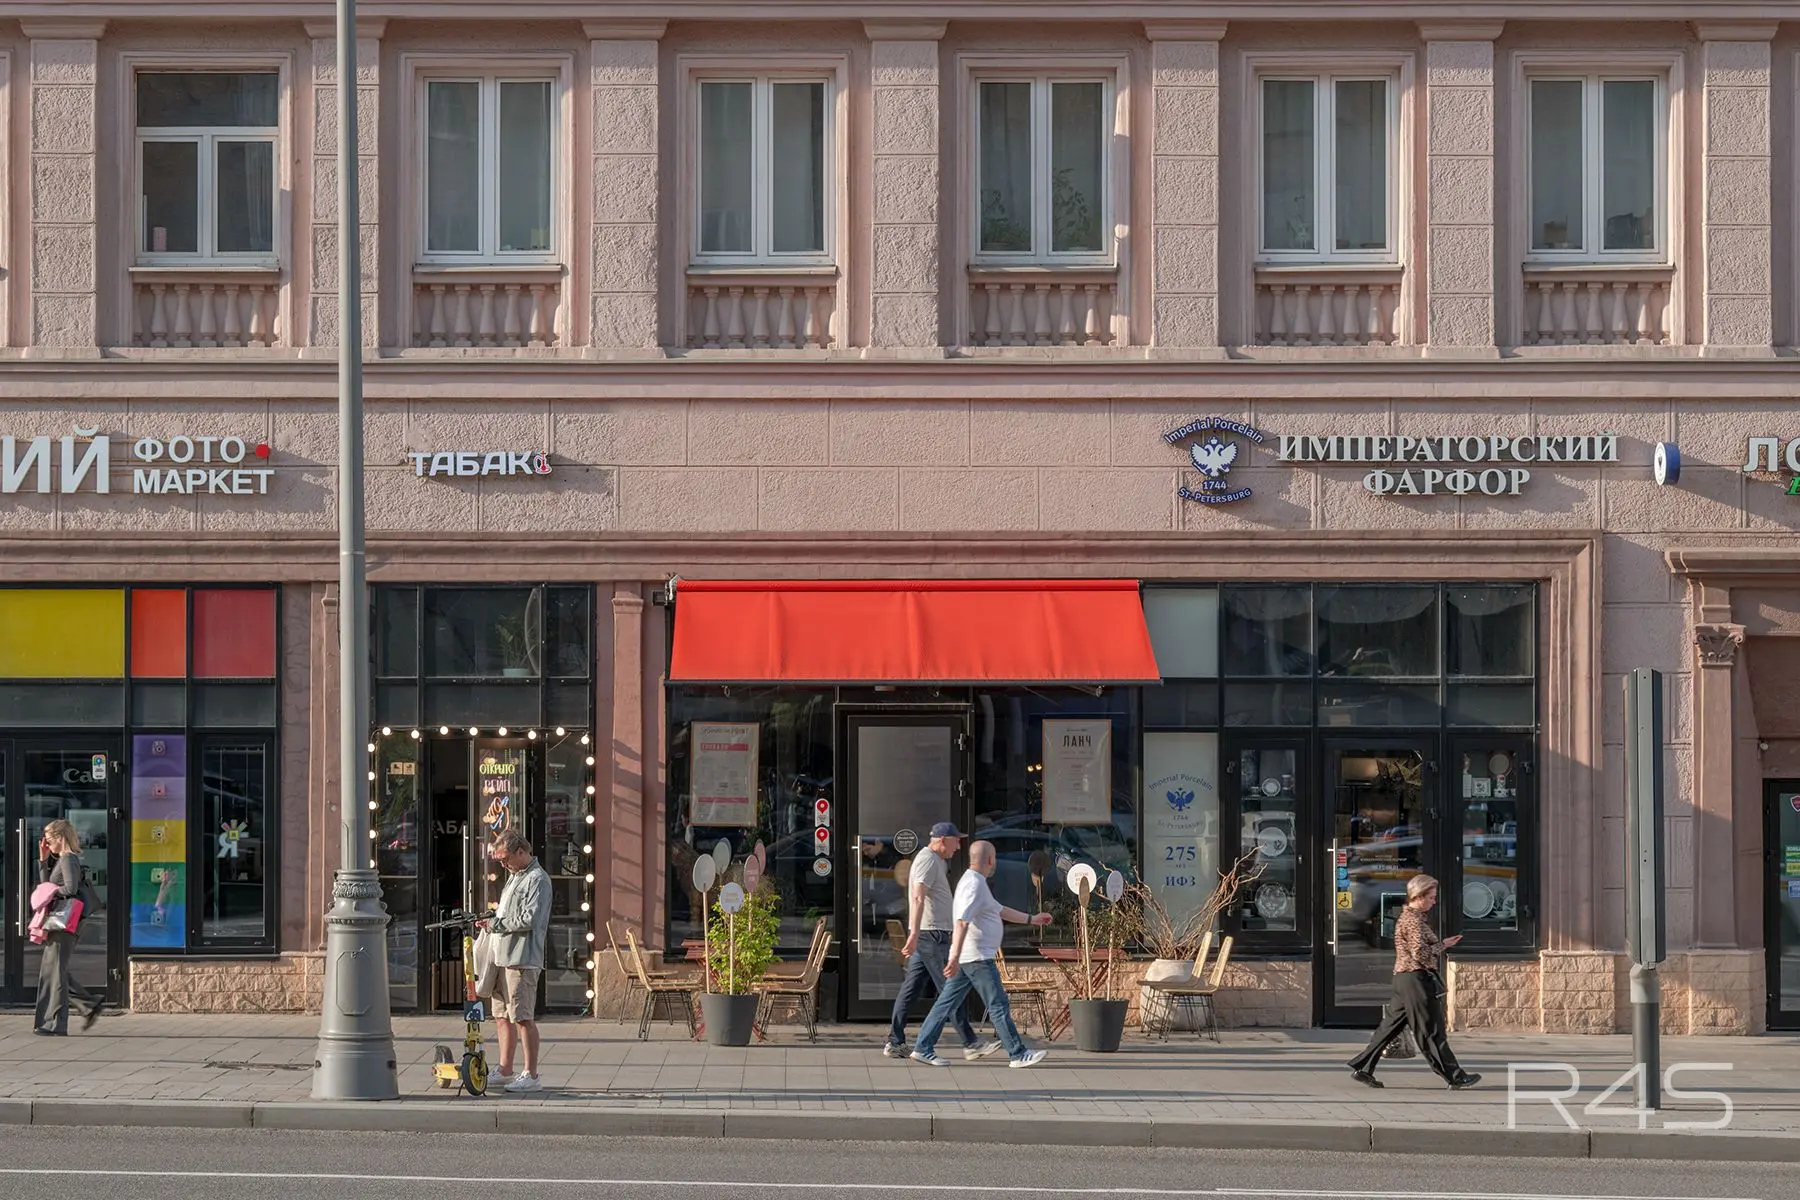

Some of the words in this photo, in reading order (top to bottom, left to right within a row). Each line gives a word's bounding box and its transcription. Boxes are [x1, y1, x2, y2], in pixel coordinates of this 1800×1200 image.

[1164, 418, 1211, 444] Imperial
[1213, 418, 1264, 445] Porcelain
[134, 435, 246, 463] ФОТО
[1276, 429, 1621, 462] ИМПЕРАТОРСКИЙ
[408, 451, 533, 476] ТАБАК
[133, 469, 275, 494] МАРКЕТ
[1202, 480, 1227, 490] 1744
[1363, 468, 1531, 496] ФАРФОР
[1178, 487, 1192, 500] ST.
[1194, 488, 1252, 503] PETERSBURG
[1063, 735, 1092, 747] ЛАНЧ
[479, 763, 515, 775] ОТКРЫТО
[1165, 846, 1196, 861] 275
[1166, 876, 1196, 887] ИФЗ
